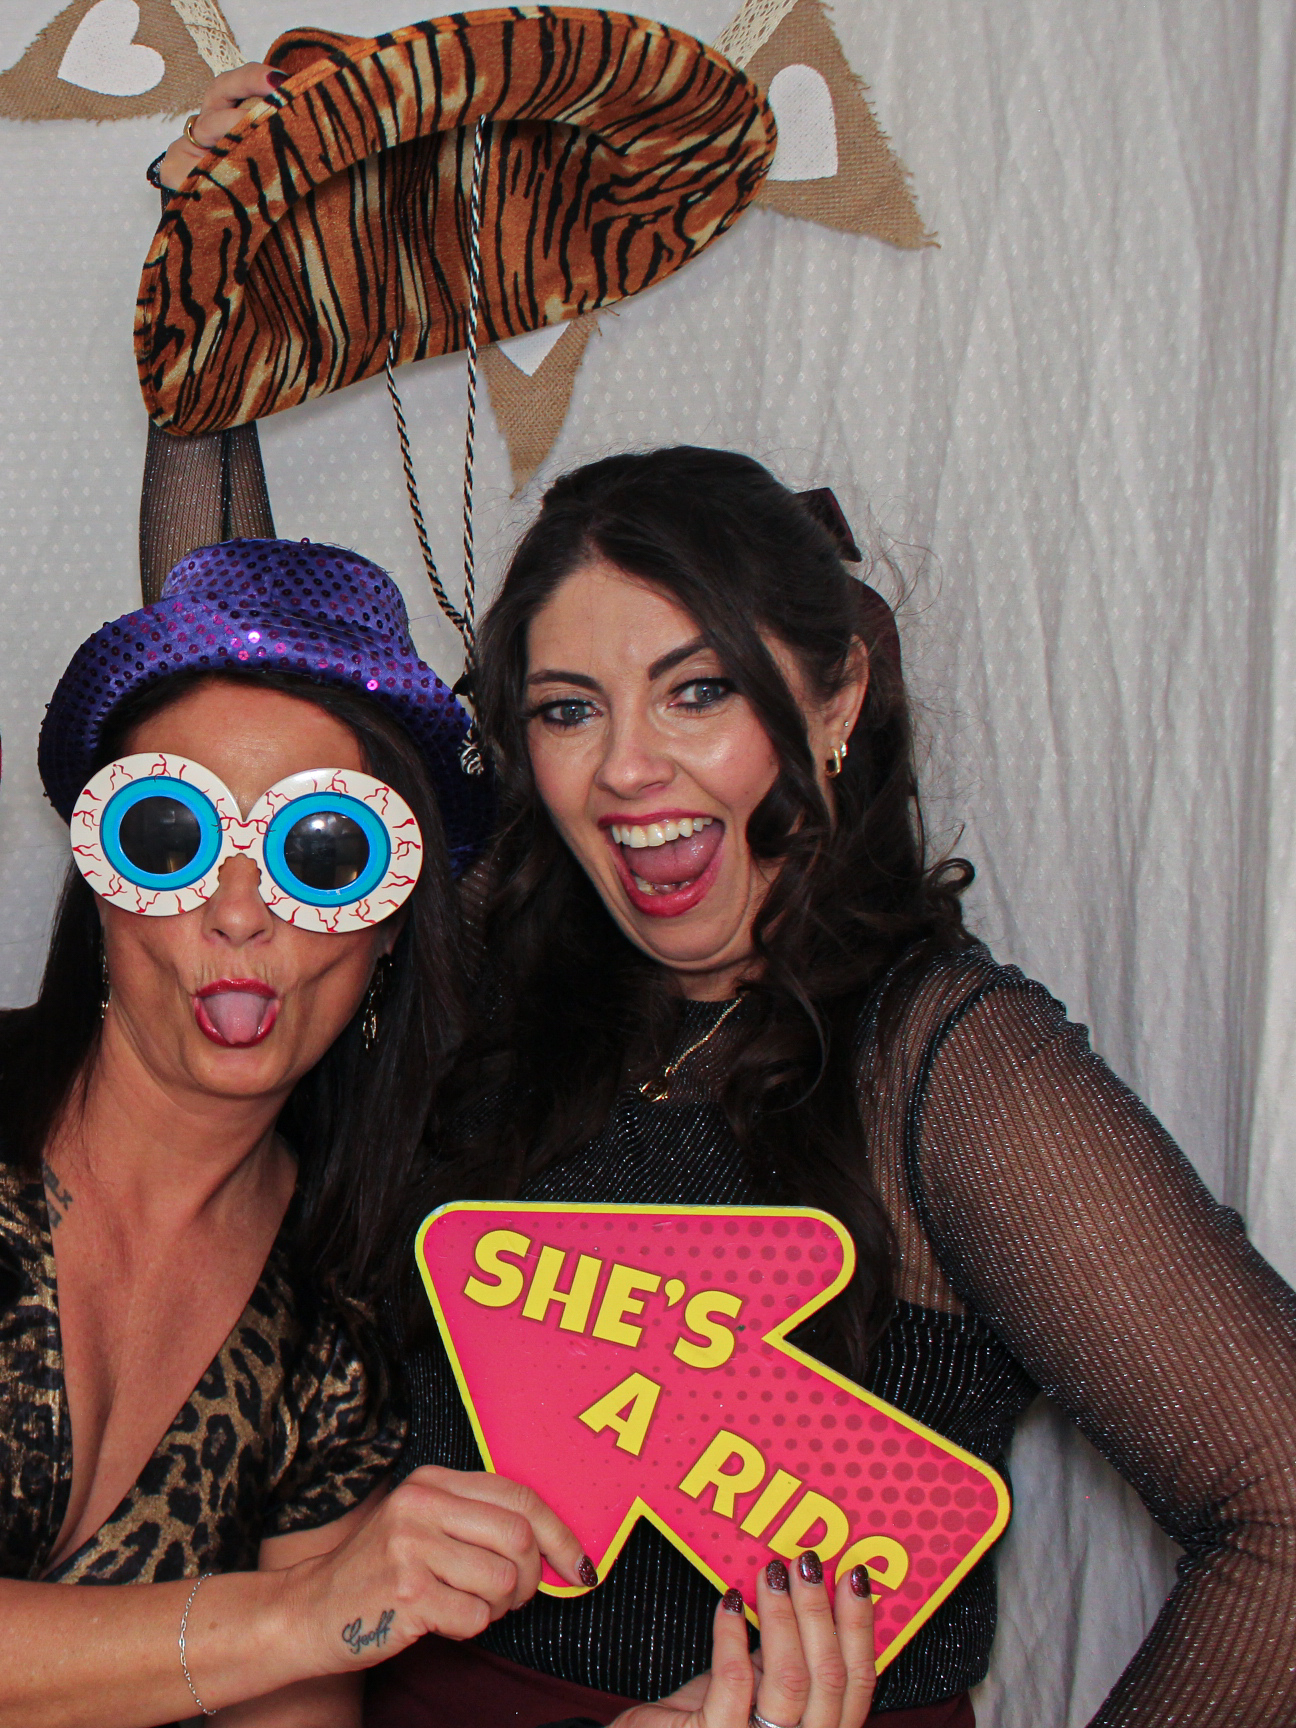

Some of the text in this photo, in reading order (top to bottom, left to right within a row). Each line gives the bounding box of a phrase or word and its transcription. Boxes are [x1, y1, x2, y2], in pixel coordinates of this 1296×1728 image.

[464, 1229, 743, 1369] SHE'S
[579, 1372, 661, 1456] A
[341, 1608, 396, 1655] Geoff
